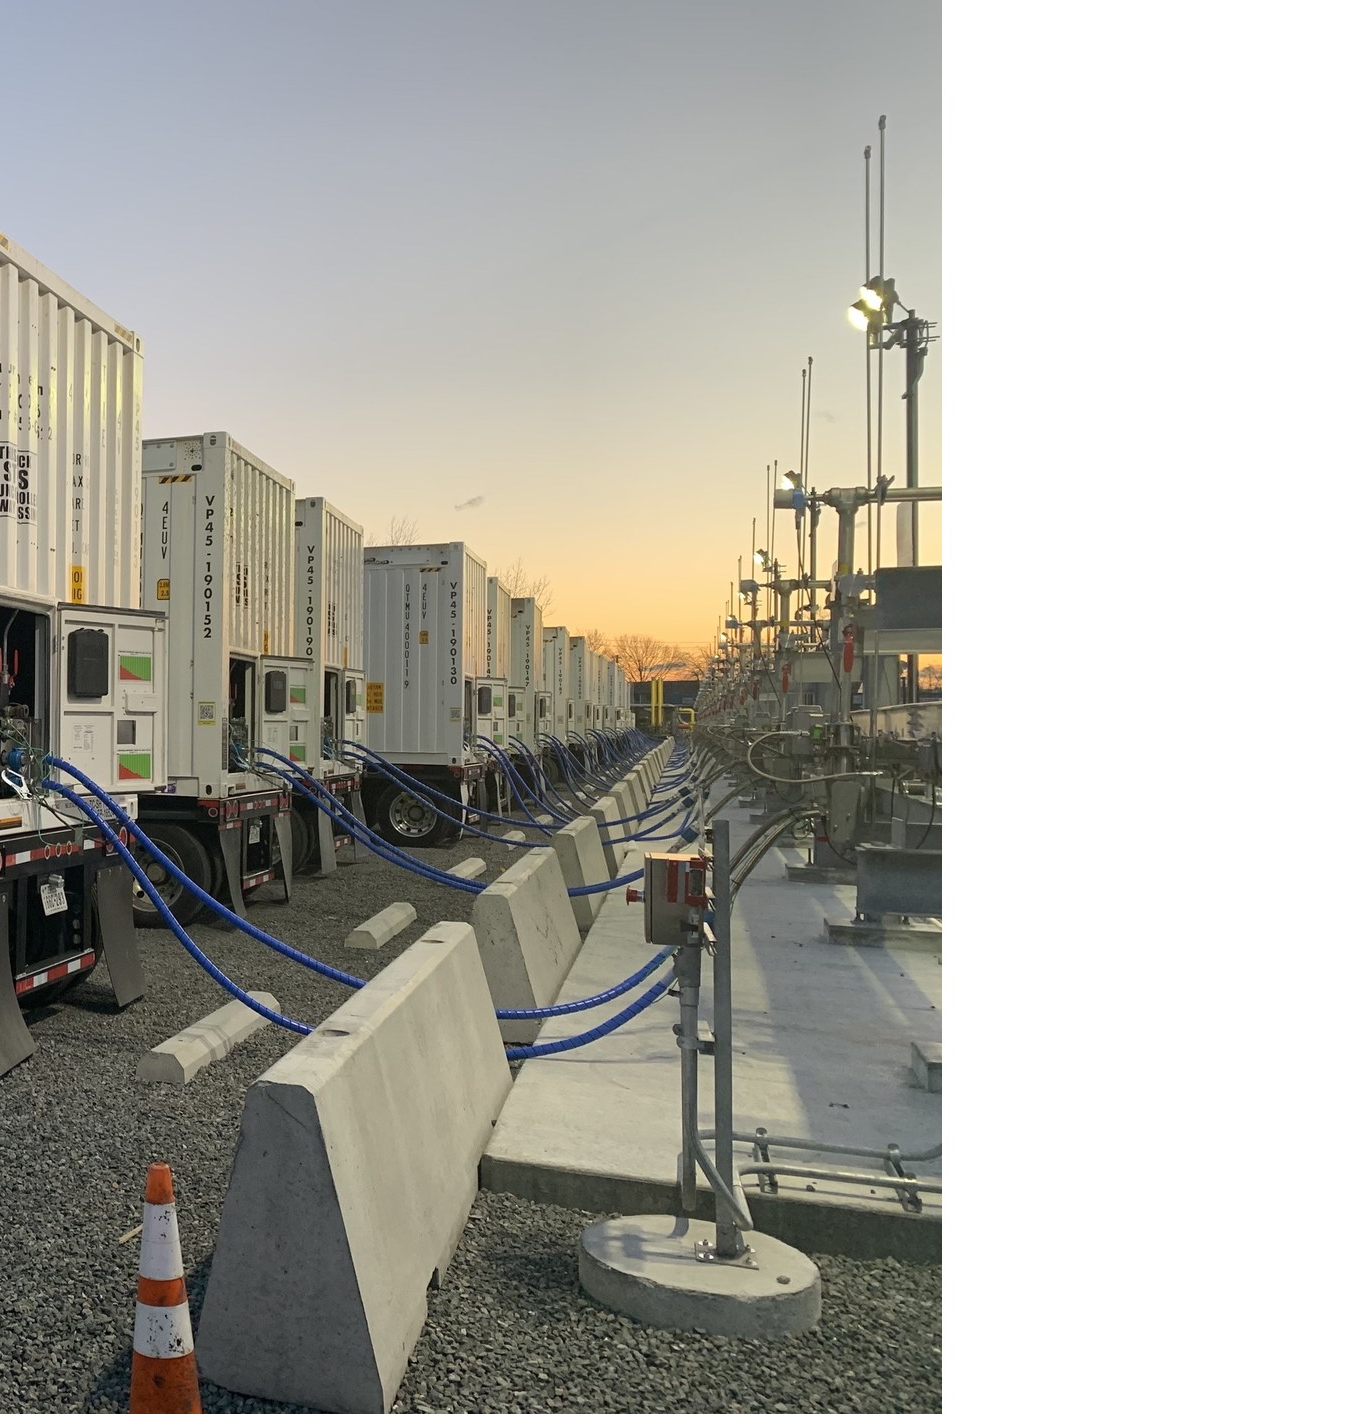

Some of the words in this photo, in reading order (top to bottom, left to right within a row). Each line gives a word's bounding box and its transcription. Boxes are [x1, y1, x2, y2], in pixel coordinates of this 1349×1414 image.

[161, 501, 169, 560] 4EUV
[203, 495, 215, 638] VP45-190152
[306, 545, 315, 656] VP45-190190
[450, 581, 458, 685] VP45-190130
